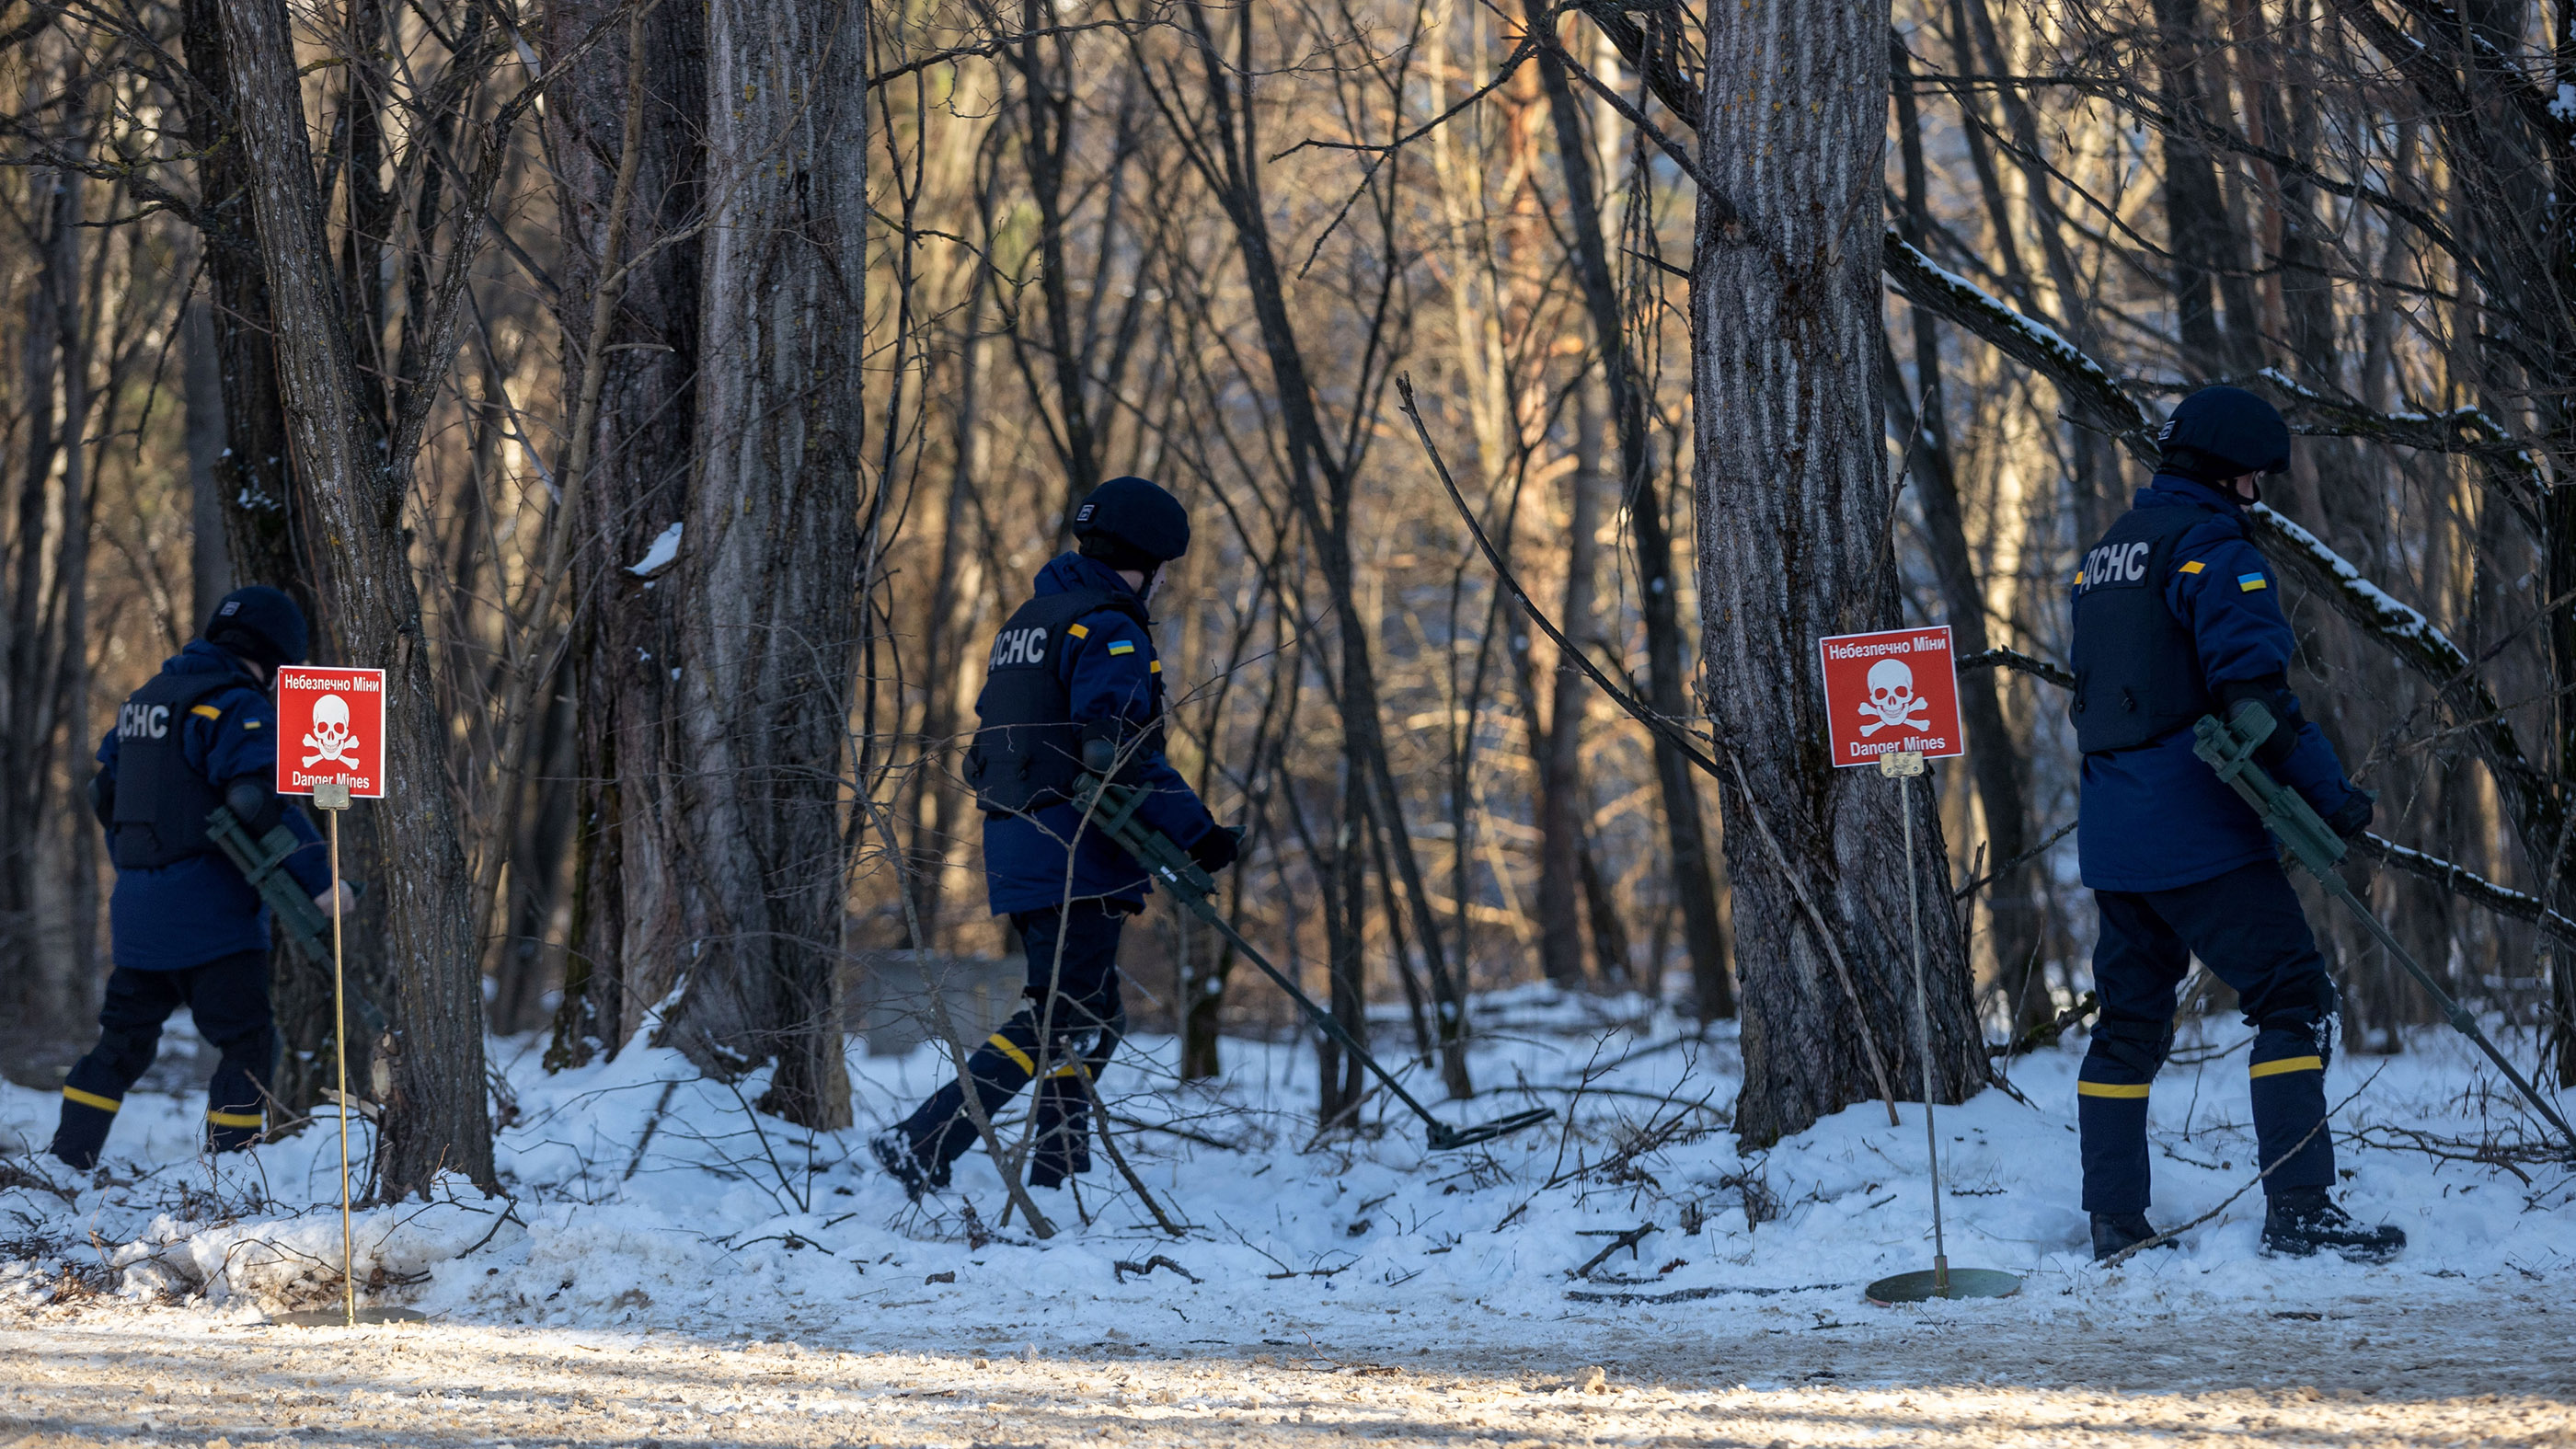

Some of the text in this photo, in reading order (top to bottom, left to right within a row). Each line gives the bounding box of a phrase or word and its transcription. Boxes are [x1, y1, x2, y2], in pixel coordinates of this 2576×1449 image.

[2079, 542, 2149, 594] ДСНС
[1829, 636, 1946, 660] Небезпечно Міни
[285, 673, 379, 692] Небезпечно Міни
[1850, 736, 1946, 757] Danger Mines
[336, 773, 370, 788] Mines
